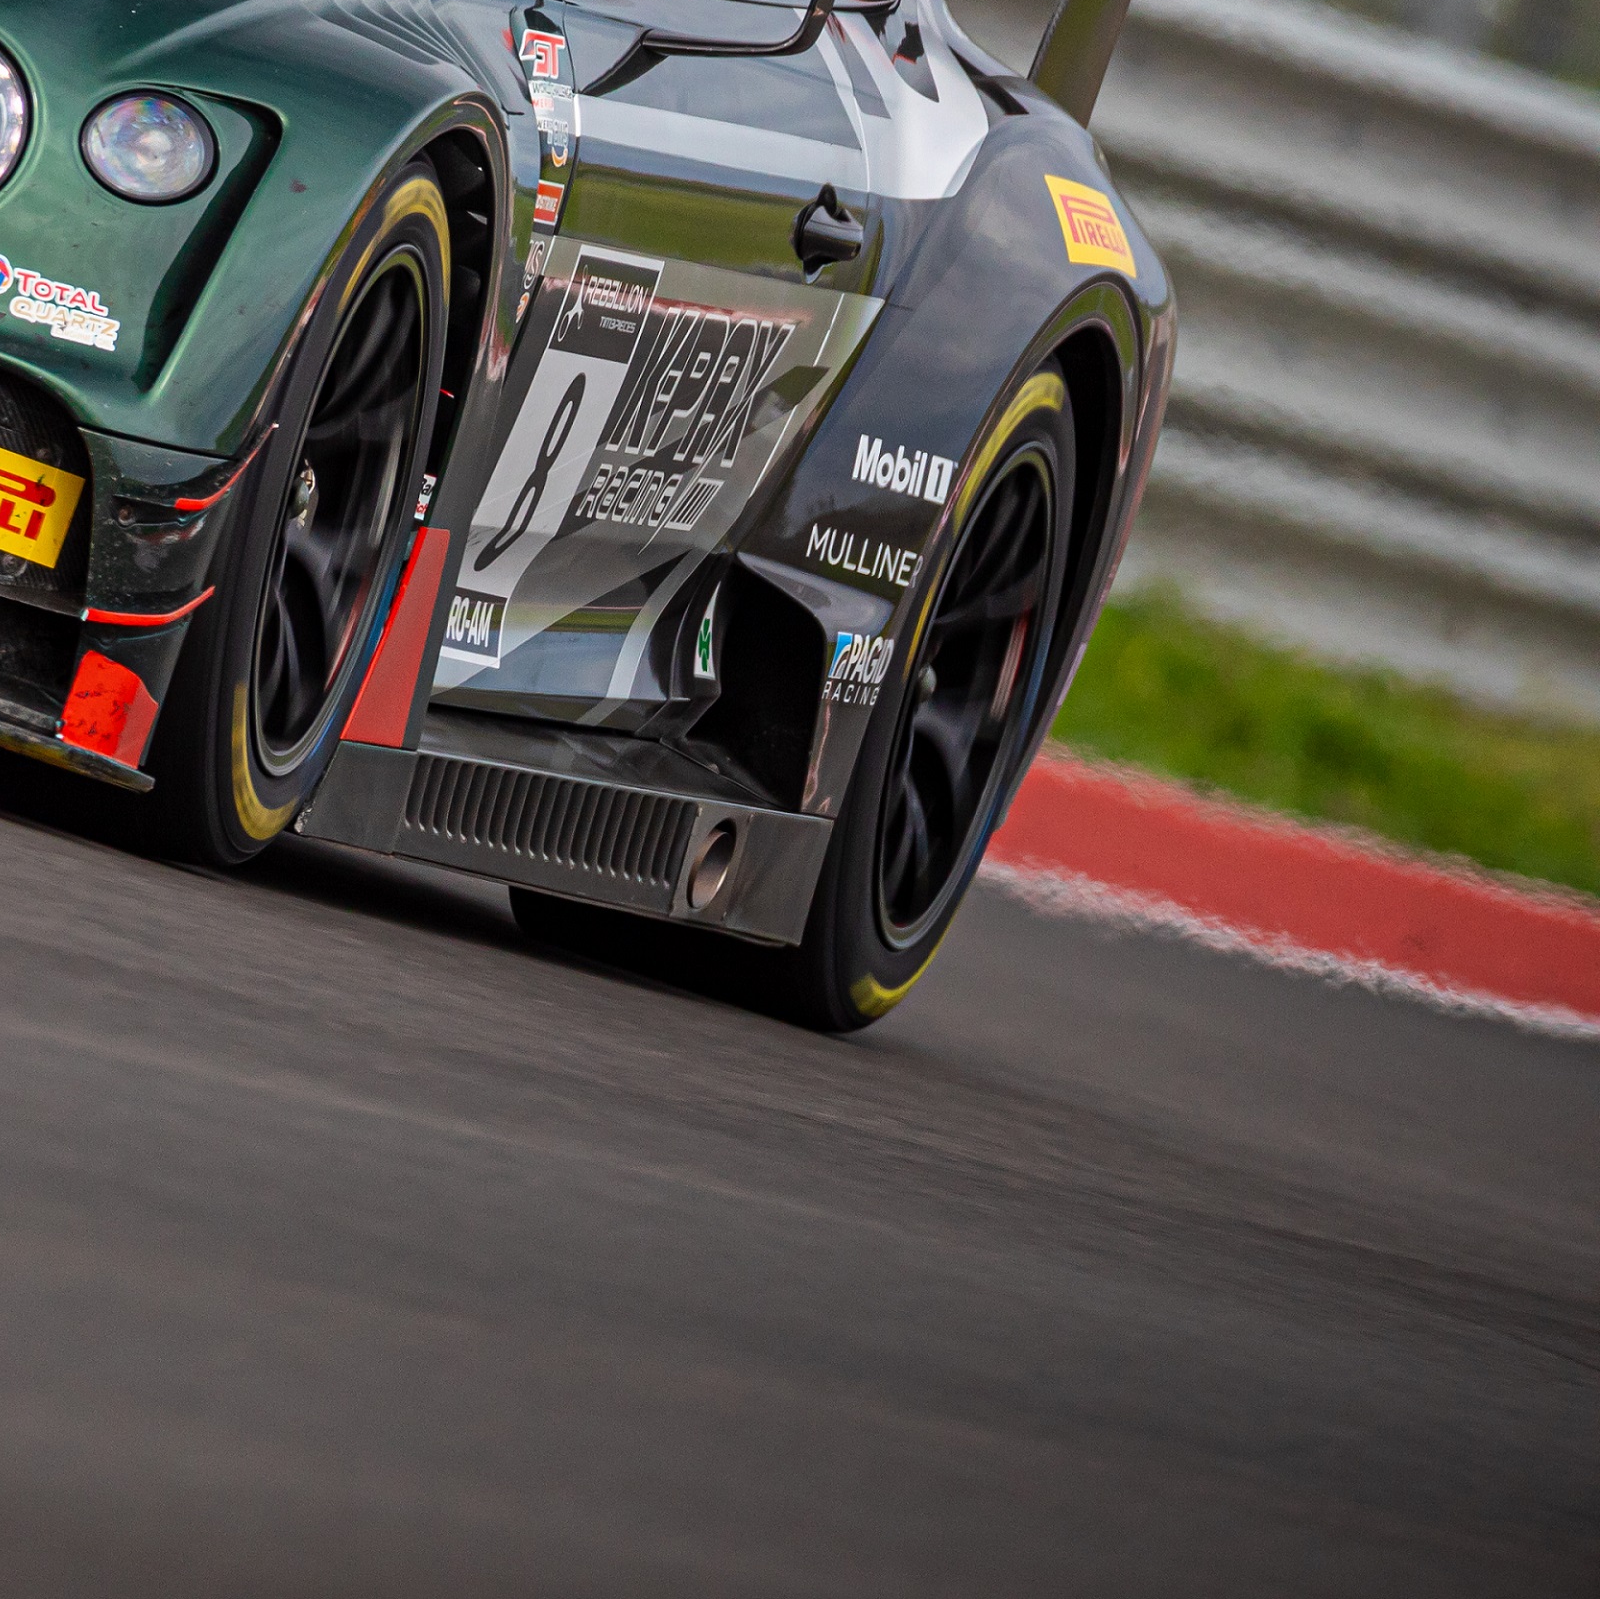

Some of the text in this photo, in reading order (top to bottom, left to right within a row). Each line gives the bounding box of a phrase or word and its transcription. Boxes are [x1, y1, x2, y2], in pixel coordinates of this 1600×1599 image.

[519, 28, 566, 80] GT
[1058, 194, 1129, 258] PIRELLI
[13, 299, 118, 337] QUARTZ
[16, 271, 107, 313] TOTAL
[604, 307, 796, 468] K-PAX
[473, 372, 587, 572] 8
[852, 433, 928, 498] Mobil
[806, 523, 924, 589] MULLINER
[446, 595, 494, 648] RO-AM
[842, 633, 895, 685] PAGID
[821, 679, 881, 707] RACING
